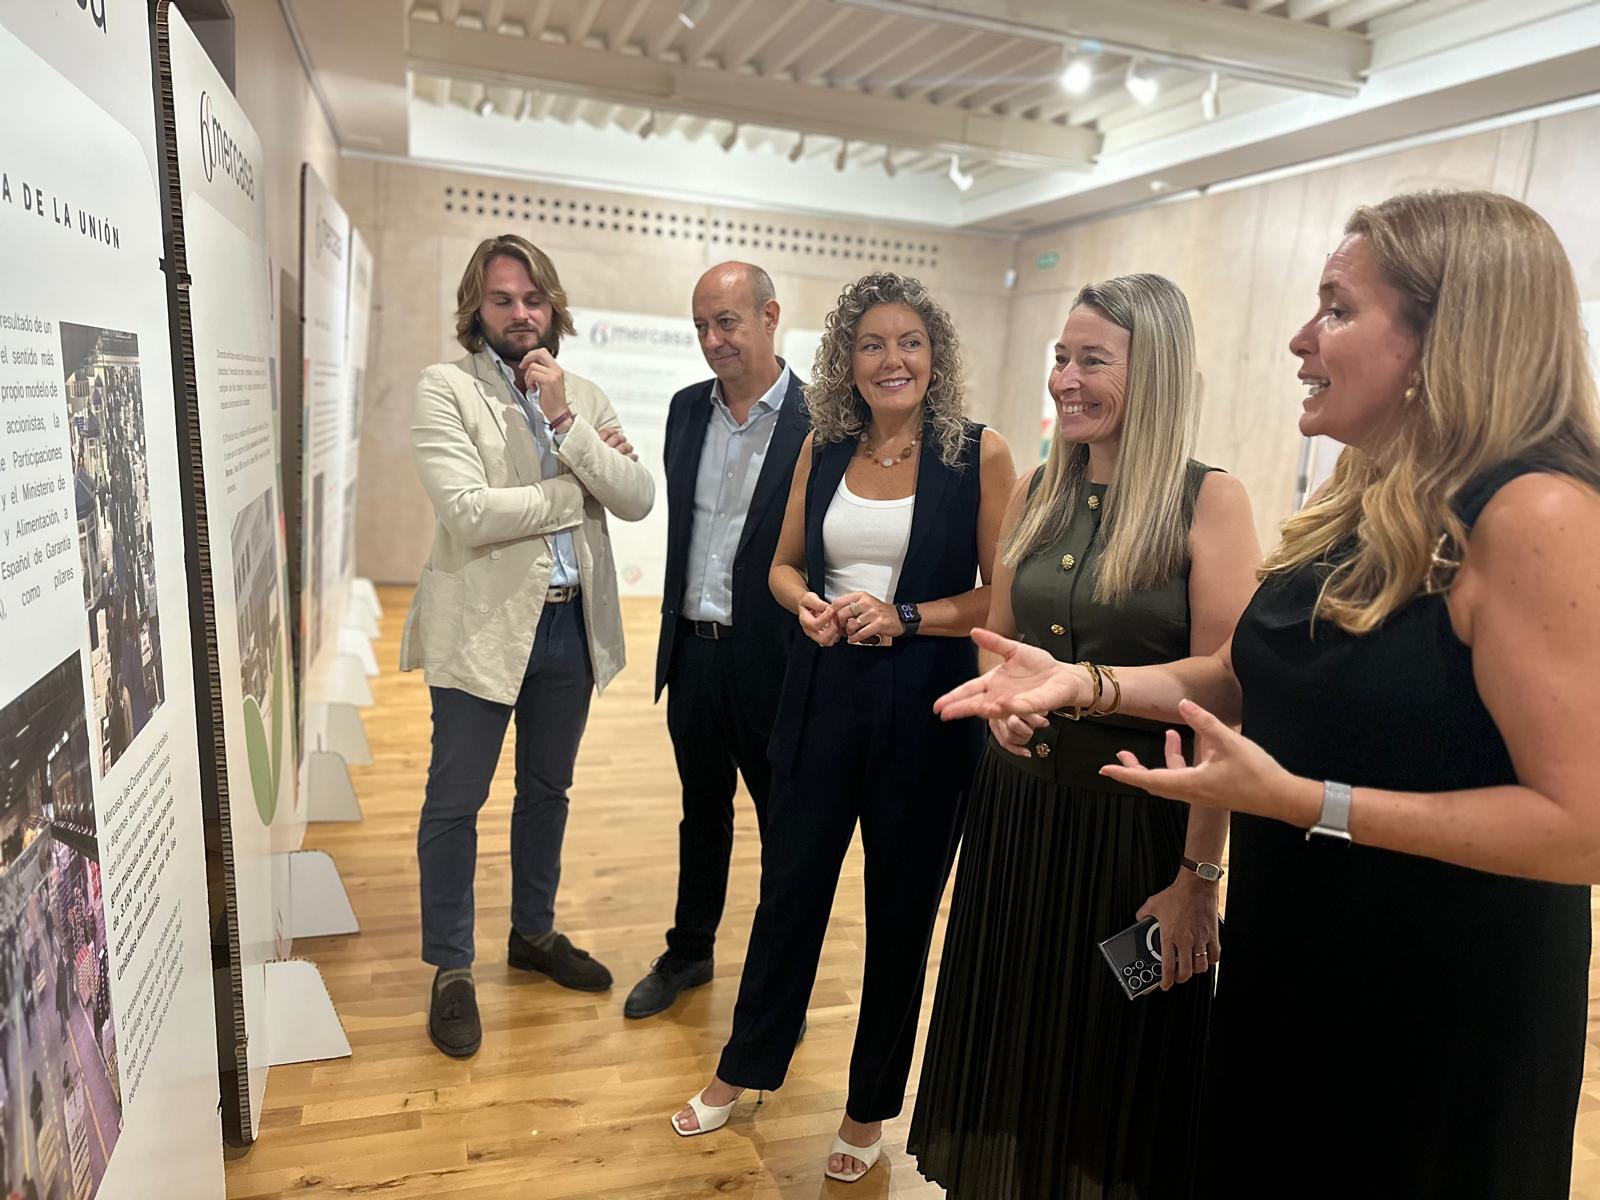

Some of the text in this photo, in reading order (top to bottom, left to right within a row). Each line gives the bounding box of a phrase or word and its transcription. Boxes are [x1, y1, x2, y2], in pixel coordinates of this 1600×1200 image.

[212, 115, 254, 201] mercasa
[23, 182, 44, 216] DE
[53, 197, 71, 229] LA
[79, 209, 119, 250] UNIÓN
[0, 312, 52, 335] resultado de un
[611, 325, 694, 347] mercasa
[0, 345, 55, 367] el sentido más
[1, 380, 58, 403] propio modelo de
[6, 412, 60, 435] accionistas, la
[13, 445, 63, 469] Participaciones
[1, 475, 66, 511] y el Ministerio de
[4, 528, 10, 547] y
[64, 507, 69, 520] a
[1, 535, 71, 581] Español de Garantía
[21, 585, 41, 607] como
[54, 567, 74, 591] pilares
[903, 611, 915, 619] 11
[110, 882, 122, 909] gran
[112, 912, 120, 932] de
[120, 887, 133, 918] 3.100
[133, 856, 152, 894] empresas
[117, 935, 137, 981] Unidades
